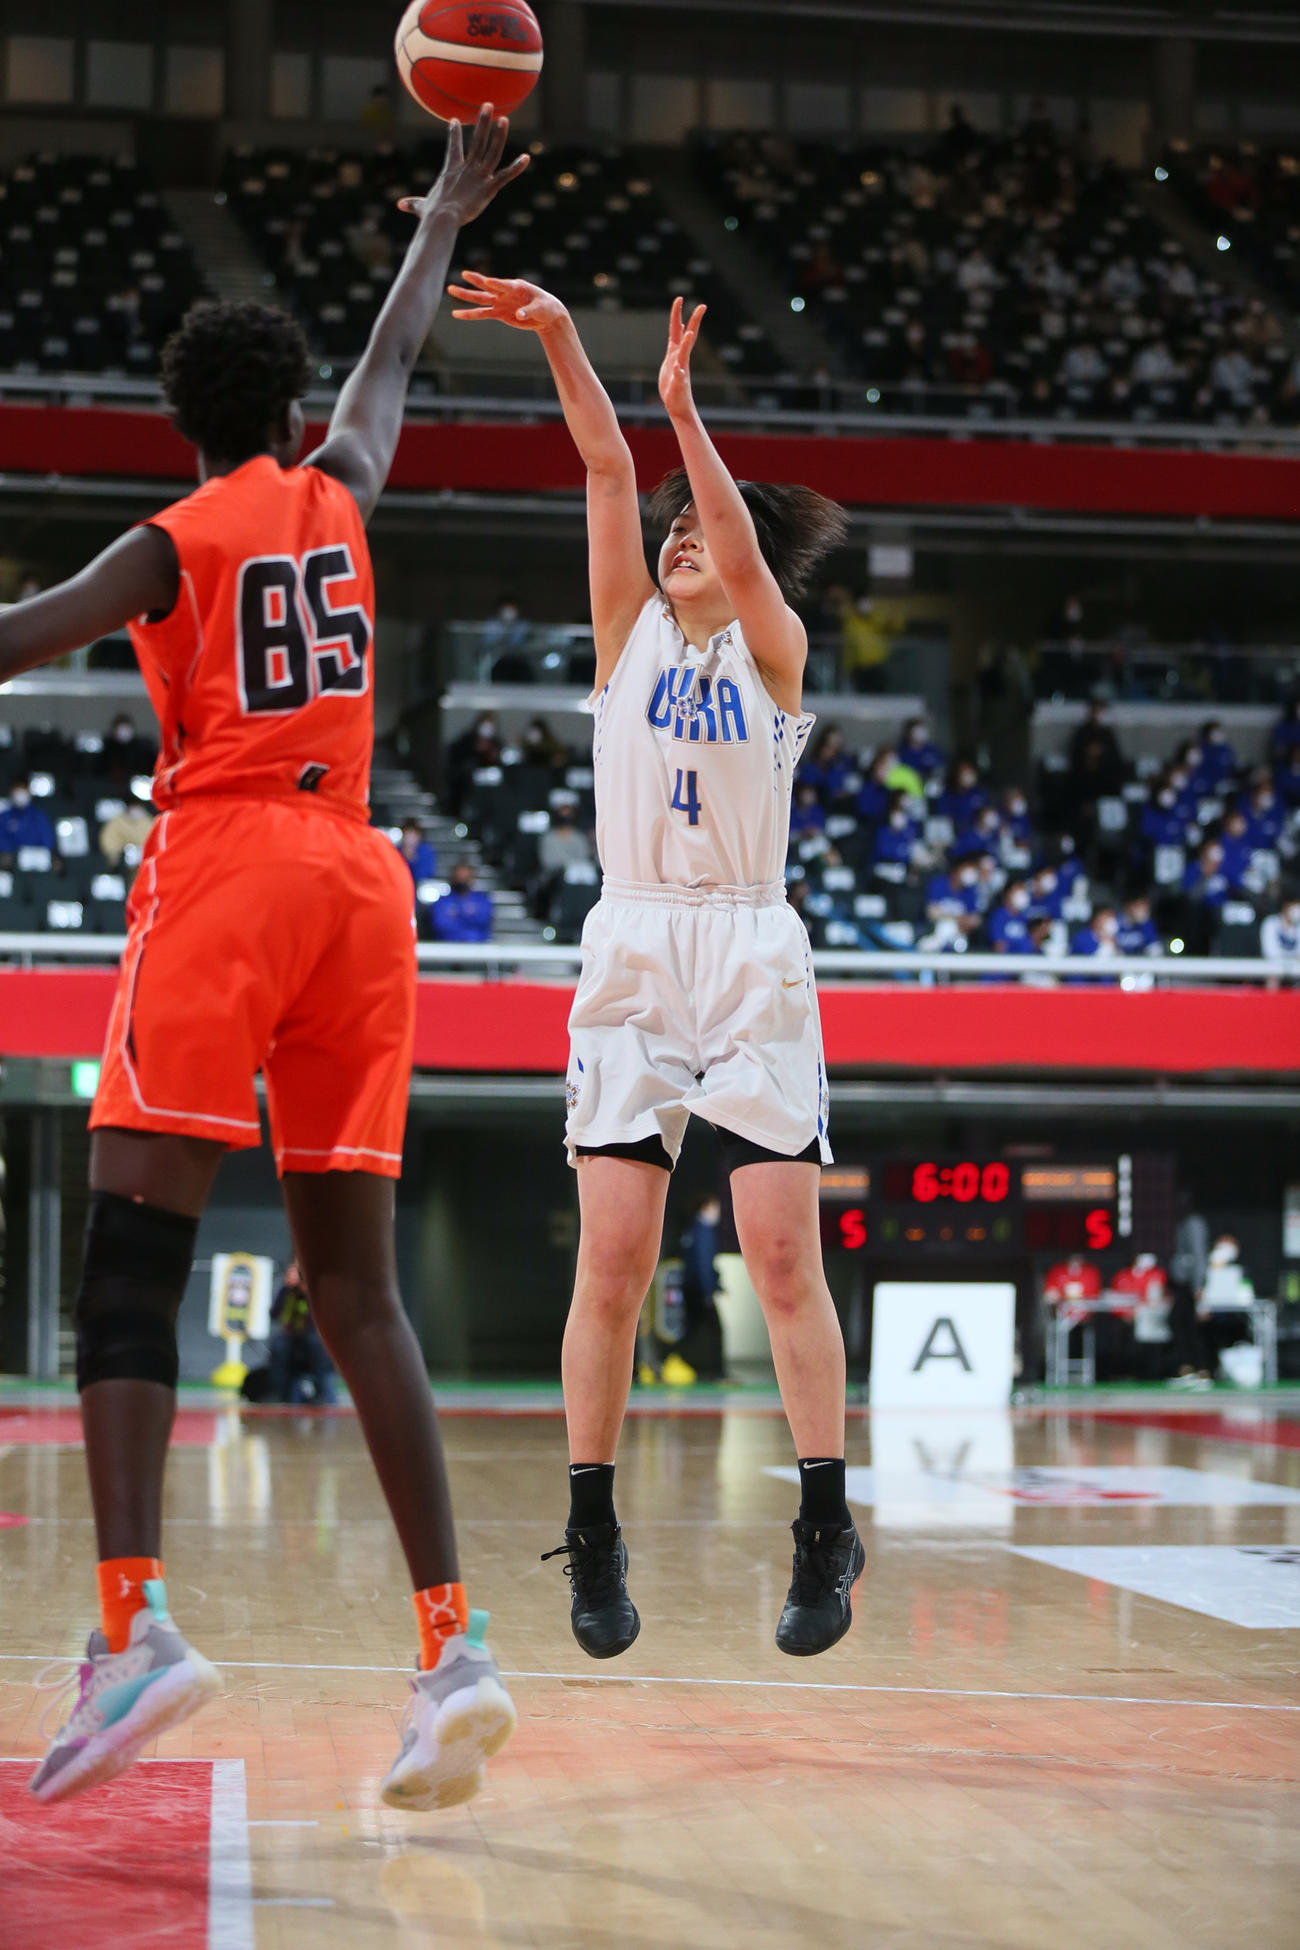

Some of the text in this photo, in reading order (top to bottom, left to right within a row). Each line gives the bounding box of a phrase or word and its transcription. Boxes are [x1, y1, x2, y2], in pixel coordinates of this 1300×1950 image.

[235, 543, 373, 718] 85
[671, 768, 702, 826] 4
[912, 1162, 1010, 1203] 6:00
[912, 1317, 972, 1372] A
